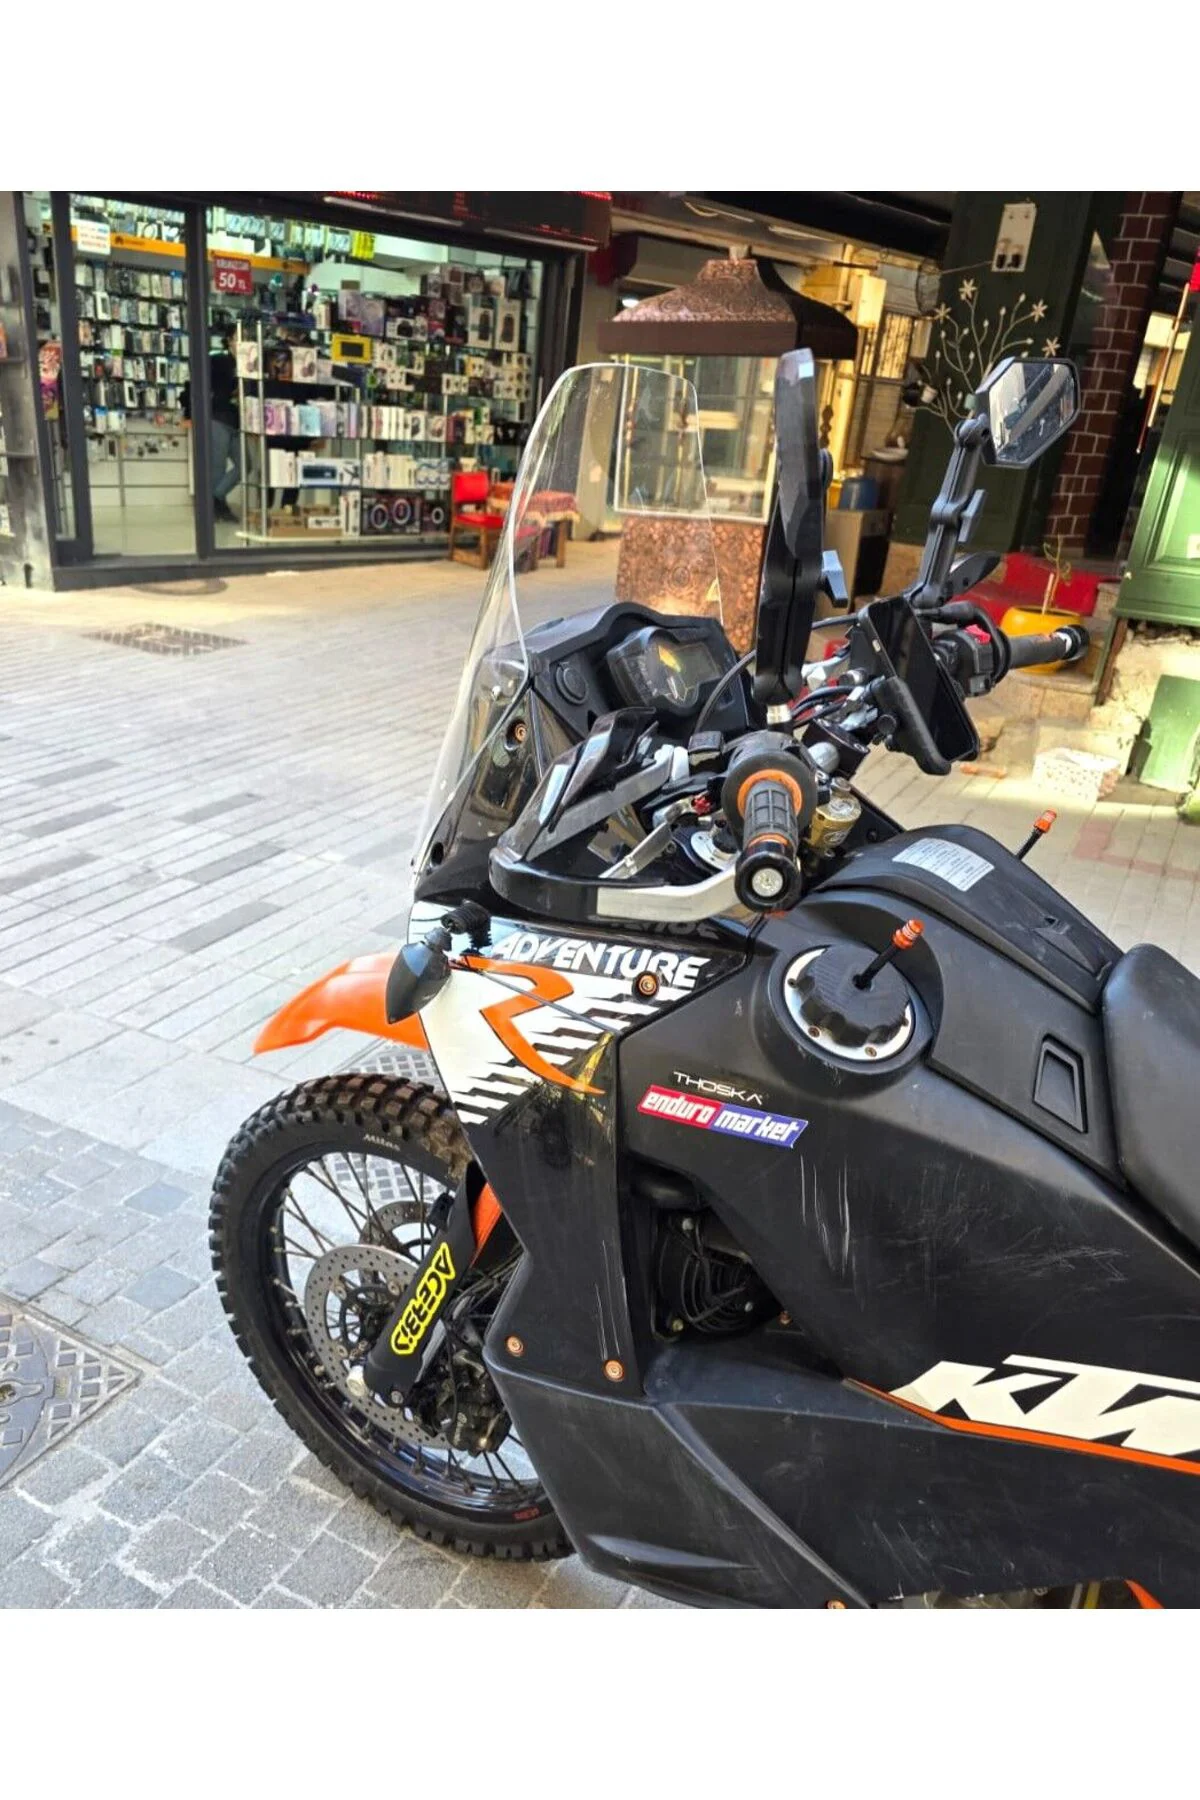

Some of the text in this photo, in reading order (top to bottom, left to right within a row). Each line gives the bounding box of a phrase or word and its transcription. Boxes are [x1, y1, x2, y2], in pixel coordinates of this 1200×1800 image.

[218, 271, 237, 289] 50
[492, 931, 711, 988] ADVENTURE
[673, 1070, 764, 1106] THOSKA
[640, 1091, 800, 1142] enduro market
